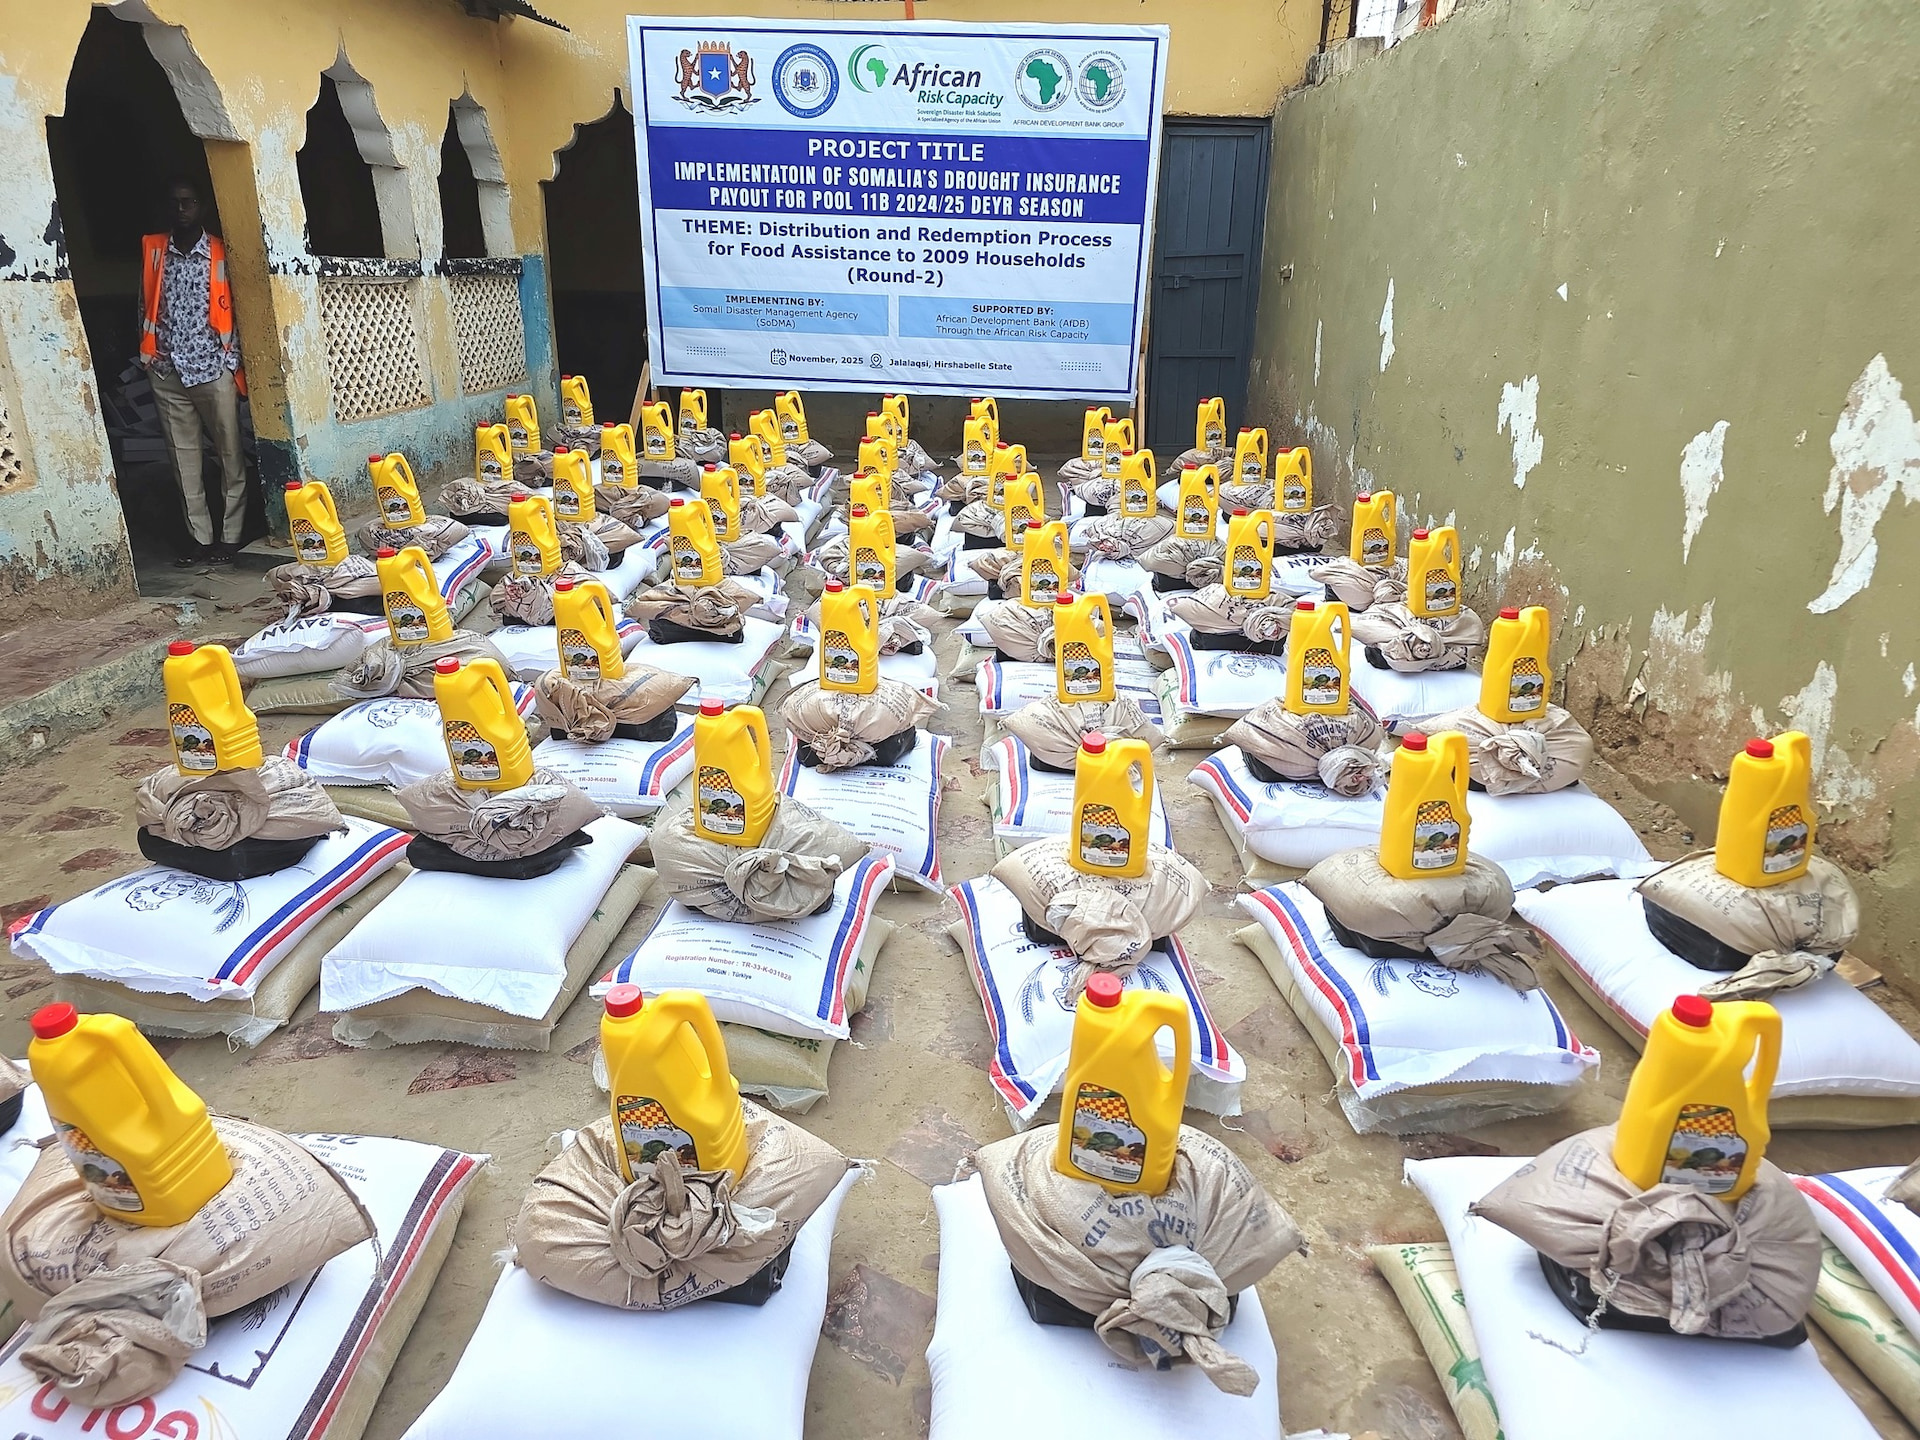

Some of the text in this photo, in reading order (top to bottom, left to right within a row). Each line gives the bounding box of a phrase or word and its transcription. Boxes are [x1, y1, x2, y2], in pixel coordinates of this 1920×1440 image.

[892, 62, 982, 93] African
[917, 89, 1004, 109] Risk Capacity
[808, 138, 985, 162] PROJECT TITLE
[674, 161, 1122, 195] IMPLEMENTATOIN OF SOMALIA'S DROUGHT INSURANCE
[709, 186, 1084, 218] PAYOUT FOR POOL 11B 2024/25 DEYR SEASON
[682, 219, 1112, 248] THEME: Distribution and Redemption Process
[708, 241, 1086, 268] for Food Assistance to 2009 Households
[847, 266, 944, 288] (Round-2)
[692, 304, 858, 320] Somali Disaster Management Agency
[725, 295, 824, 306] IMPLEMENTING BY:
[972, 304, 1054, 316] SUPPORTED BY:
[756, 318, 796, 330] (SoDMA)
[936, 314, 1090, 329] African Development Bank (AfDB)
[936, 325, 1090, 341] Through the African Risk Capacity
[789, 354, 864, 366] November, 2025
[889, 358, 1013, 371] Jalalaqsi, Hirshabelle State
[1287, 556, 1335, 568] AYAN
[261, 616, 332, 641] RAYAN
[868, 771, 906, 783] 25Kg
[706, 967, 727, 976] ORIGIN
[708, 956, 735, 966] Number
[741, 961, 793, 981] TR-33-K-031828
[242, 1151, 262, 1170] Year
[272, 1153, 298, 1181] added
[295, 1183, 308, 1200] No
[299, 1166, 320, 1194] Store
[253, 1186, 278, 1222] Month
[267, 1177, 291, 1214] Month
[221, 1209, 248, 1242] Serial
[1080, 1217, 1112, 1248] LTD.
[211, 1231, 231, 1256] Net
